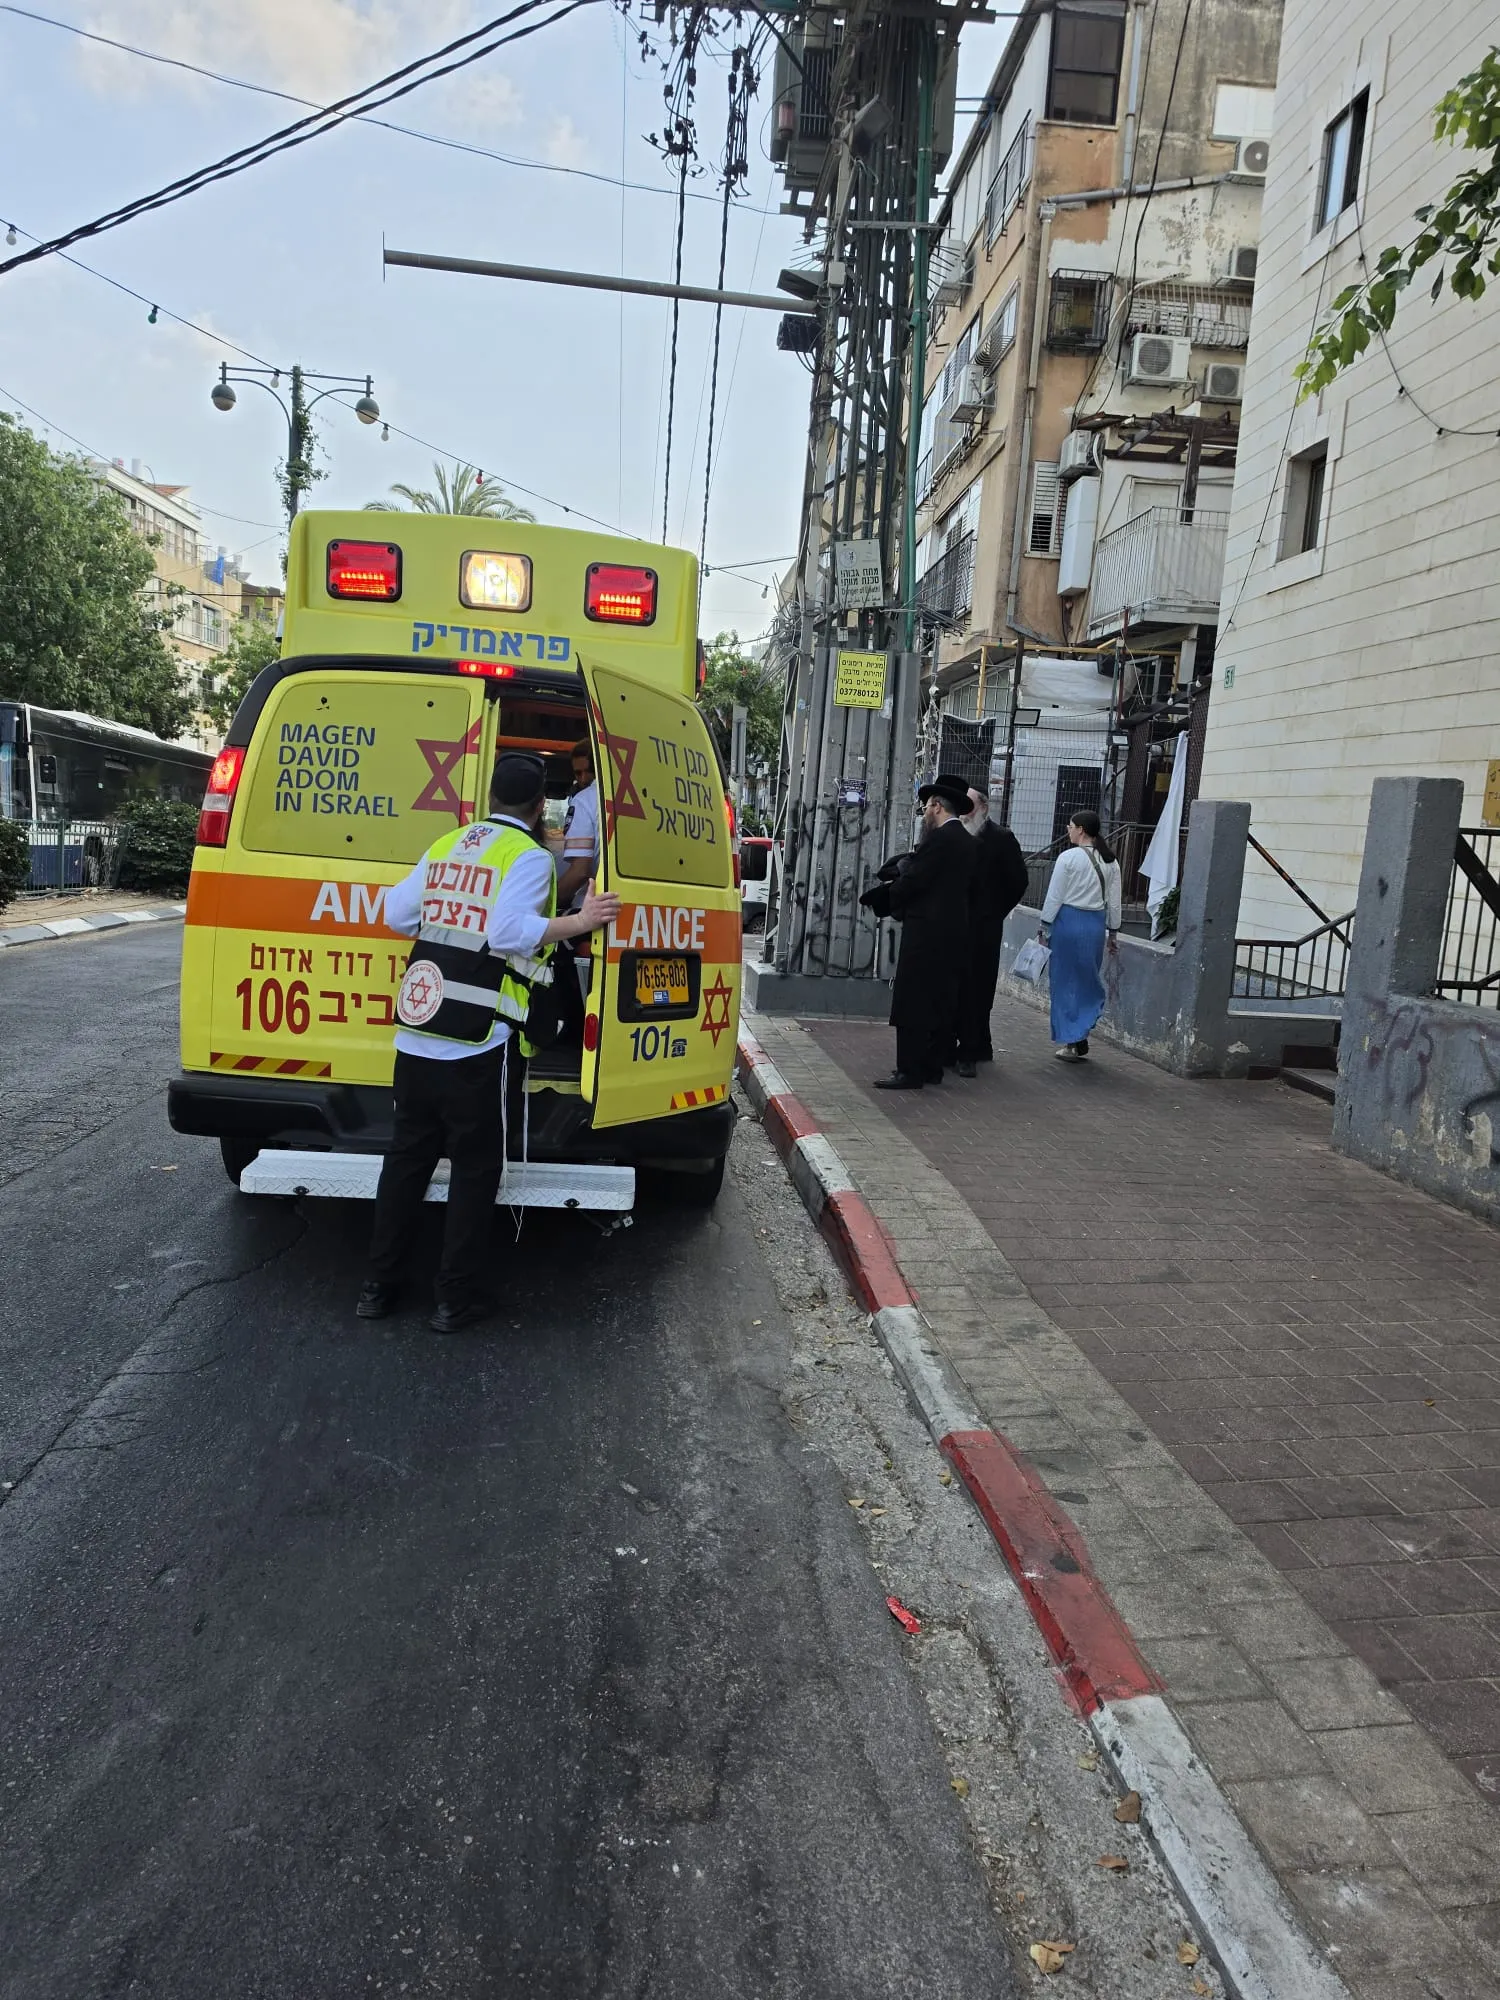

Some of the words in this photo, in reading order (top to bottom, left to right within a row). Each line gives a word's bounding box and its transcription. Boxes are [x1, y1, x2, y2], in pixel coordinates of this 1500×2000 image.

[840, 568, 860, 578] גבוה!
[861, 576, 880, 585] סכנת
[863, 567, 879, 577] מתח
[412, 622, 570, 661] פראמדיק
[839, 687, 879, 698] 037780123
[1226, 669, 1233, 685] 51
[280, 723, 376, 746] MAGEN
[278, 745, 360, 768] DAVID
[648, 735, 679, 769] דוד
[683, 746, 709, 778] מגן
[276, 768, 360, 791] ADOM
[675, 776, 714, 812] אדום
[275, 791, 302, 812] IN
[312, 792, 400, 818] ISRAEL
[651, 798, 716, 844] בישראל
[424, 862, 494, 898] חובש
[309, 881, 391, 926] AM
[608, 905, 706, 950] LANCE
[250, 942, 313, 974] אדום
[327, 950, 374, 978] דוד
[388, 954, 409, 984] גן
[236, 977, 311, 1035] 106
[319, 990, 394, 1026] ביב
[630, 1025, 672, 1062] 101
